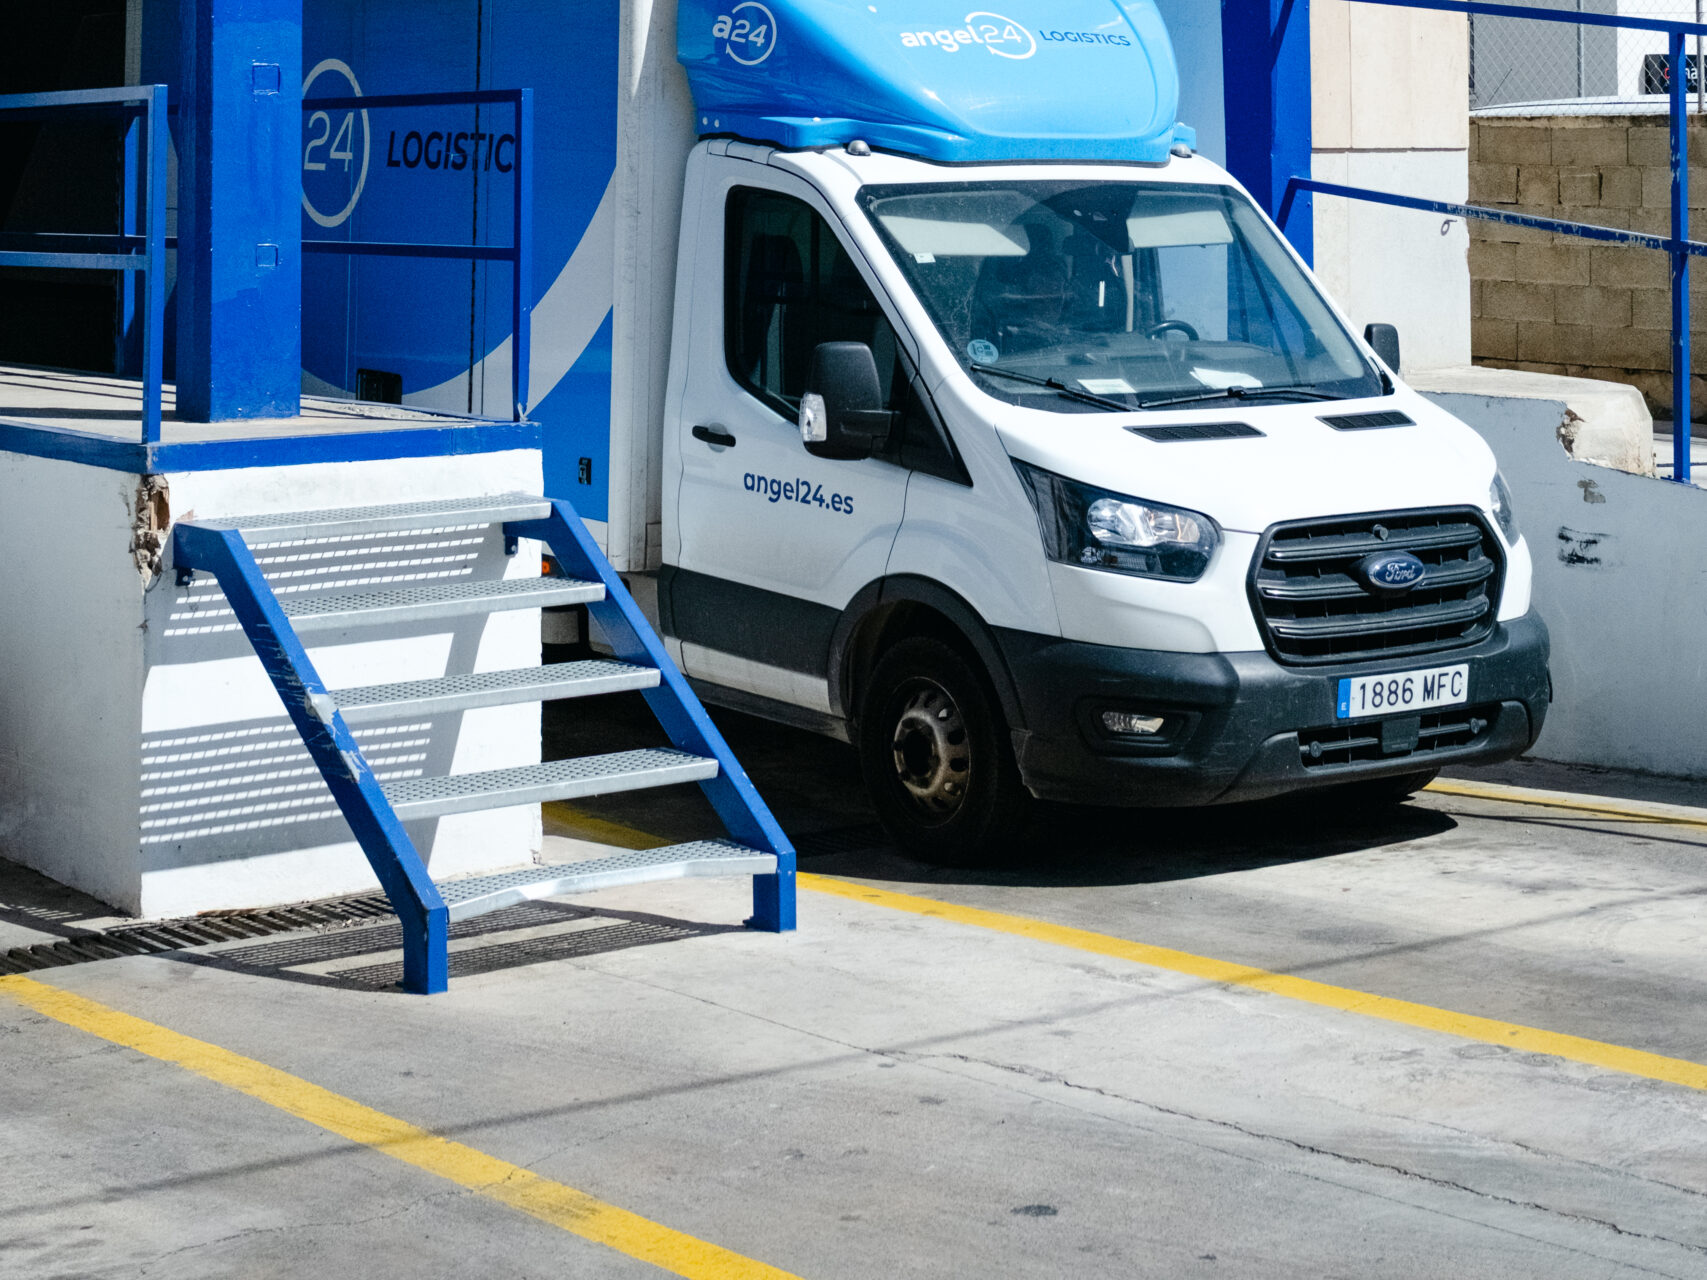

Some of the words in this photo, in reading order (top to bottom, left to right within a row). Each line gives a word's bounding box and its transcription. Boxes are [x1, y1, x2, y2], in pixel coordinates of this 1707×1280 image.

[712, 14, 768, 47] a24
[900, 24, 1022, 53] angel24
[1039, 29, 1132, 47] LOGISTICS
[386, 131, 516, 173] LOGISTIC
[743, 472, 854, 515] angel24.es
[1385, 562, 1416, 582] Ford
[1360, 677, 1414, 710] 1886
[1423, 671, 1463, 702] MFC
